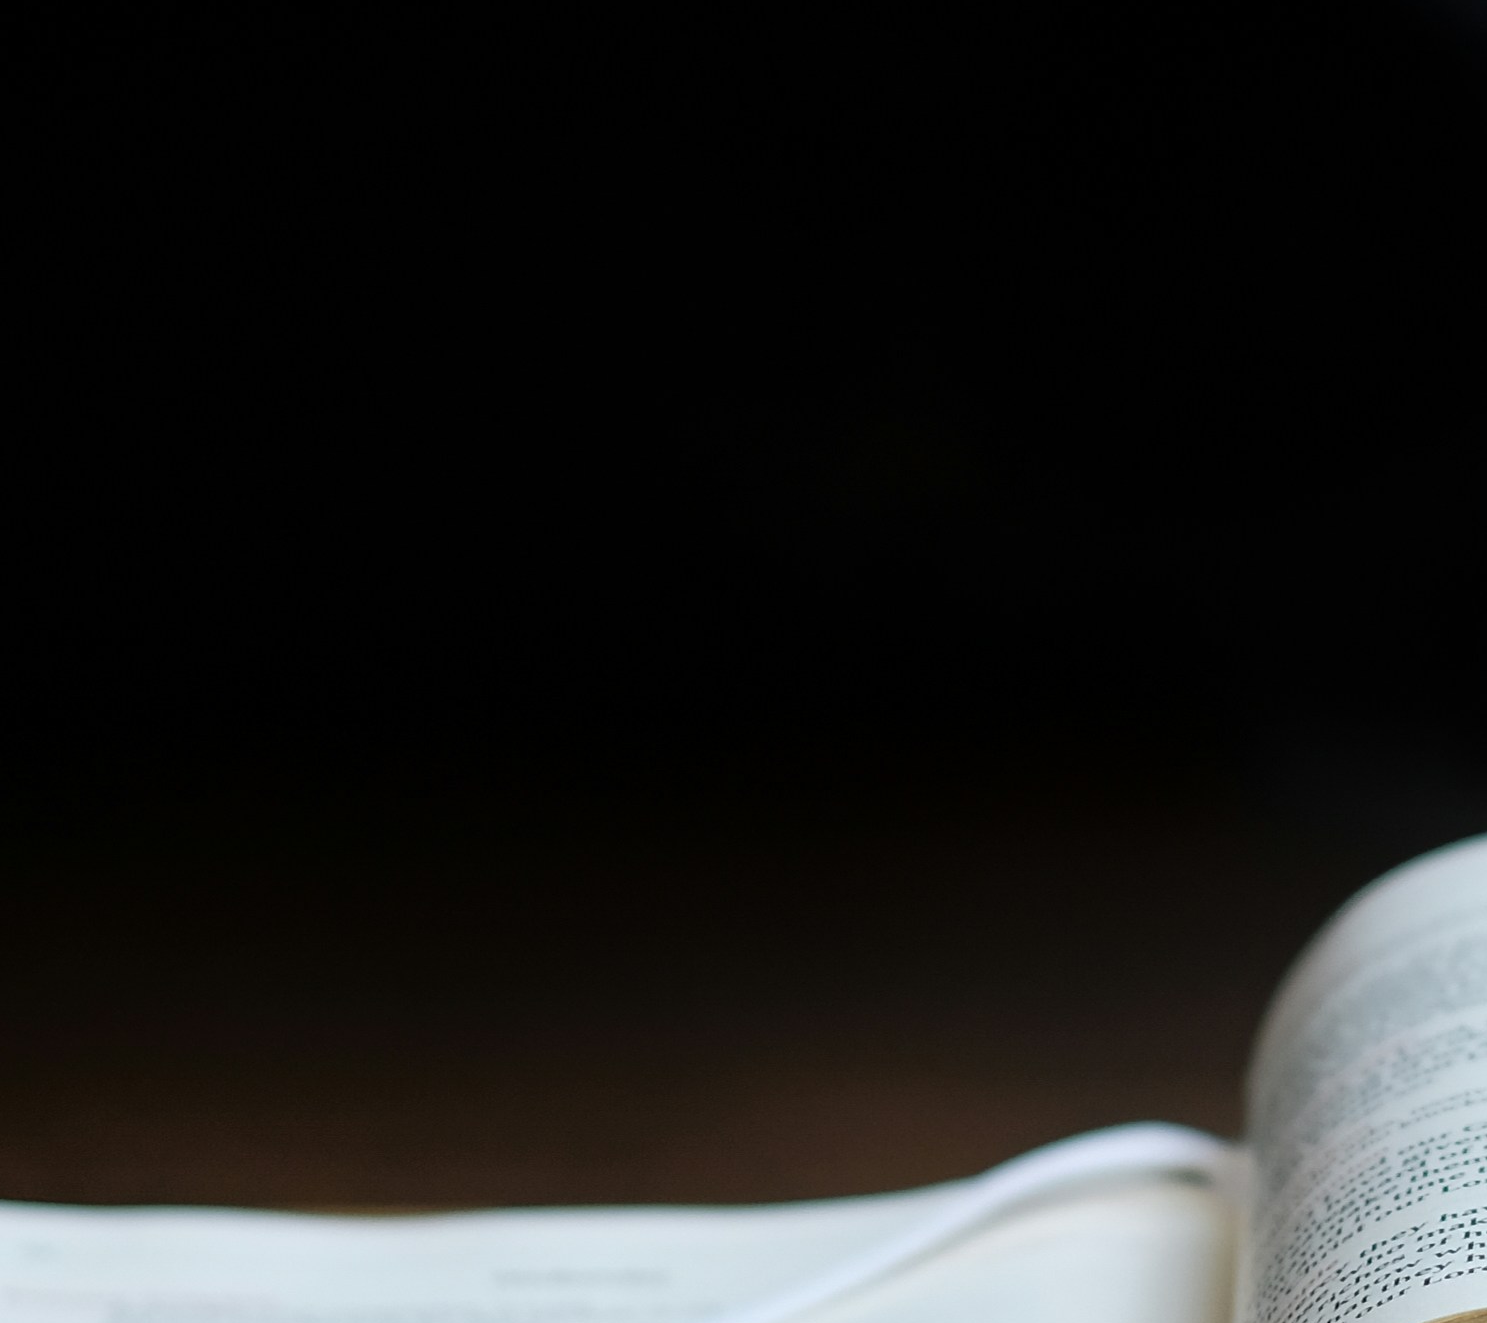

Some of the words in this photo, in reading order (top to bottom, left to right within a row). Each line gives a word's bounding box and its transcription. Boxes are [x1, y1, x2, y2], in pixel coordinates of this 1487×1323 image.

[1374, 1193, 1430, 1223] our
[1359, 1221, 1430, 1260] they
[1416, 1234, 1452, 1254] of
[1339, 1243, 1406, 1283] who
[1380, 1261, 1453, 1293] they
[1333, 1257, 1423, 1312] know
[1355, 1286, 1412, 1319] our
